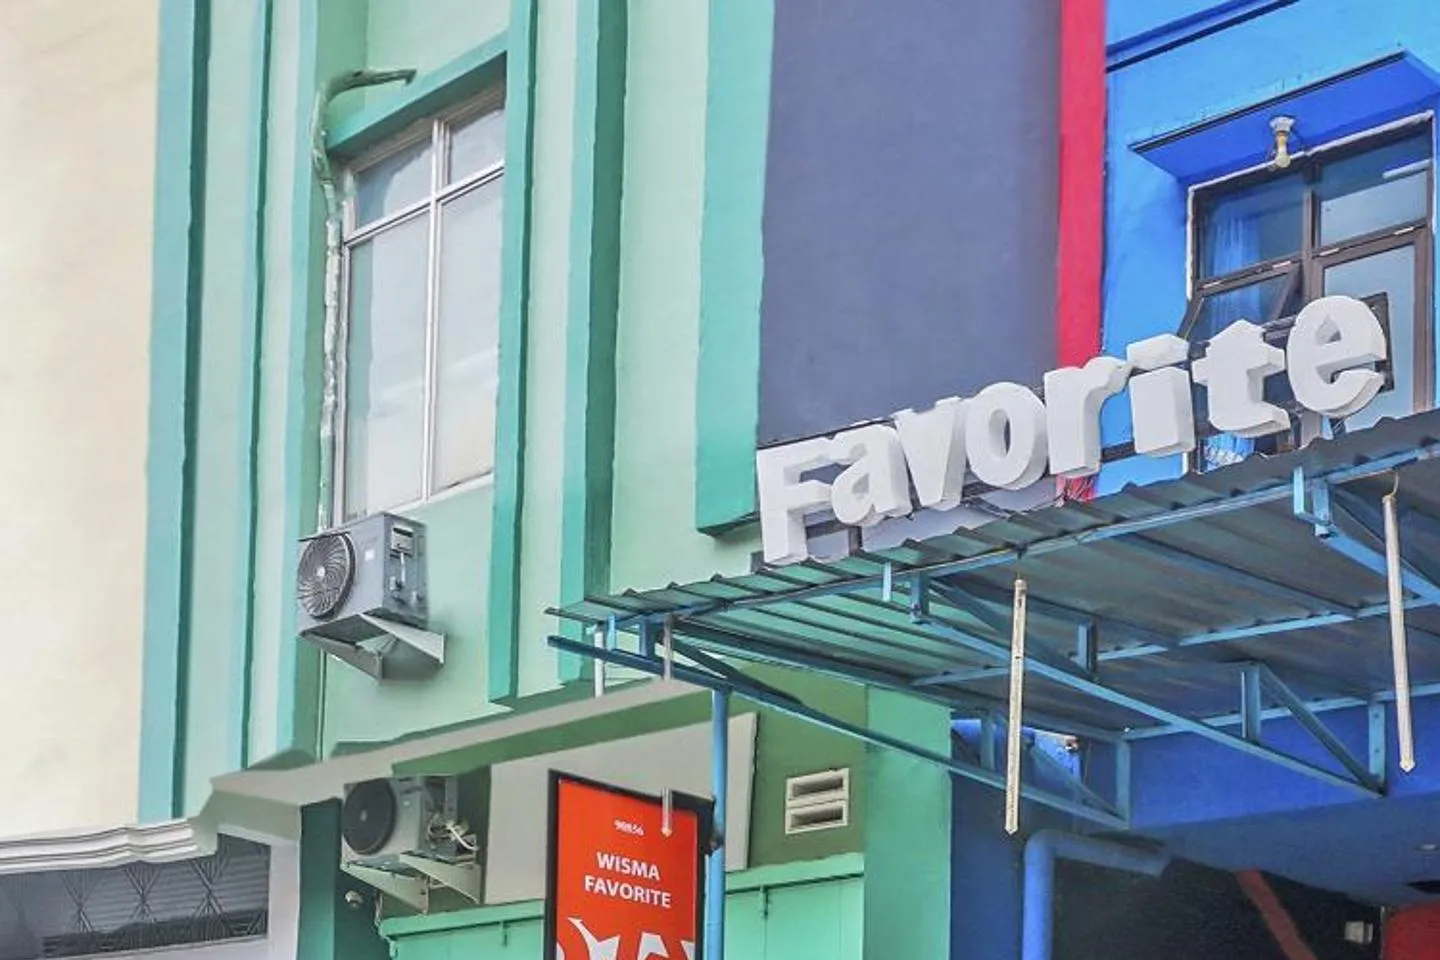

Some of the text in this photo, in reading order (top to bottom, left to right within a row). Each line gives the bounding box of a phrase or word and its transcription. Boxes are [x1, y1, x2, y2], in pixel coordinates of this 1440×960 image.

[756, 294, 1388, 565] Favorite
[596, 851, 661, 881] WISMA
[585, 875, 672, 908] FAVORITE
